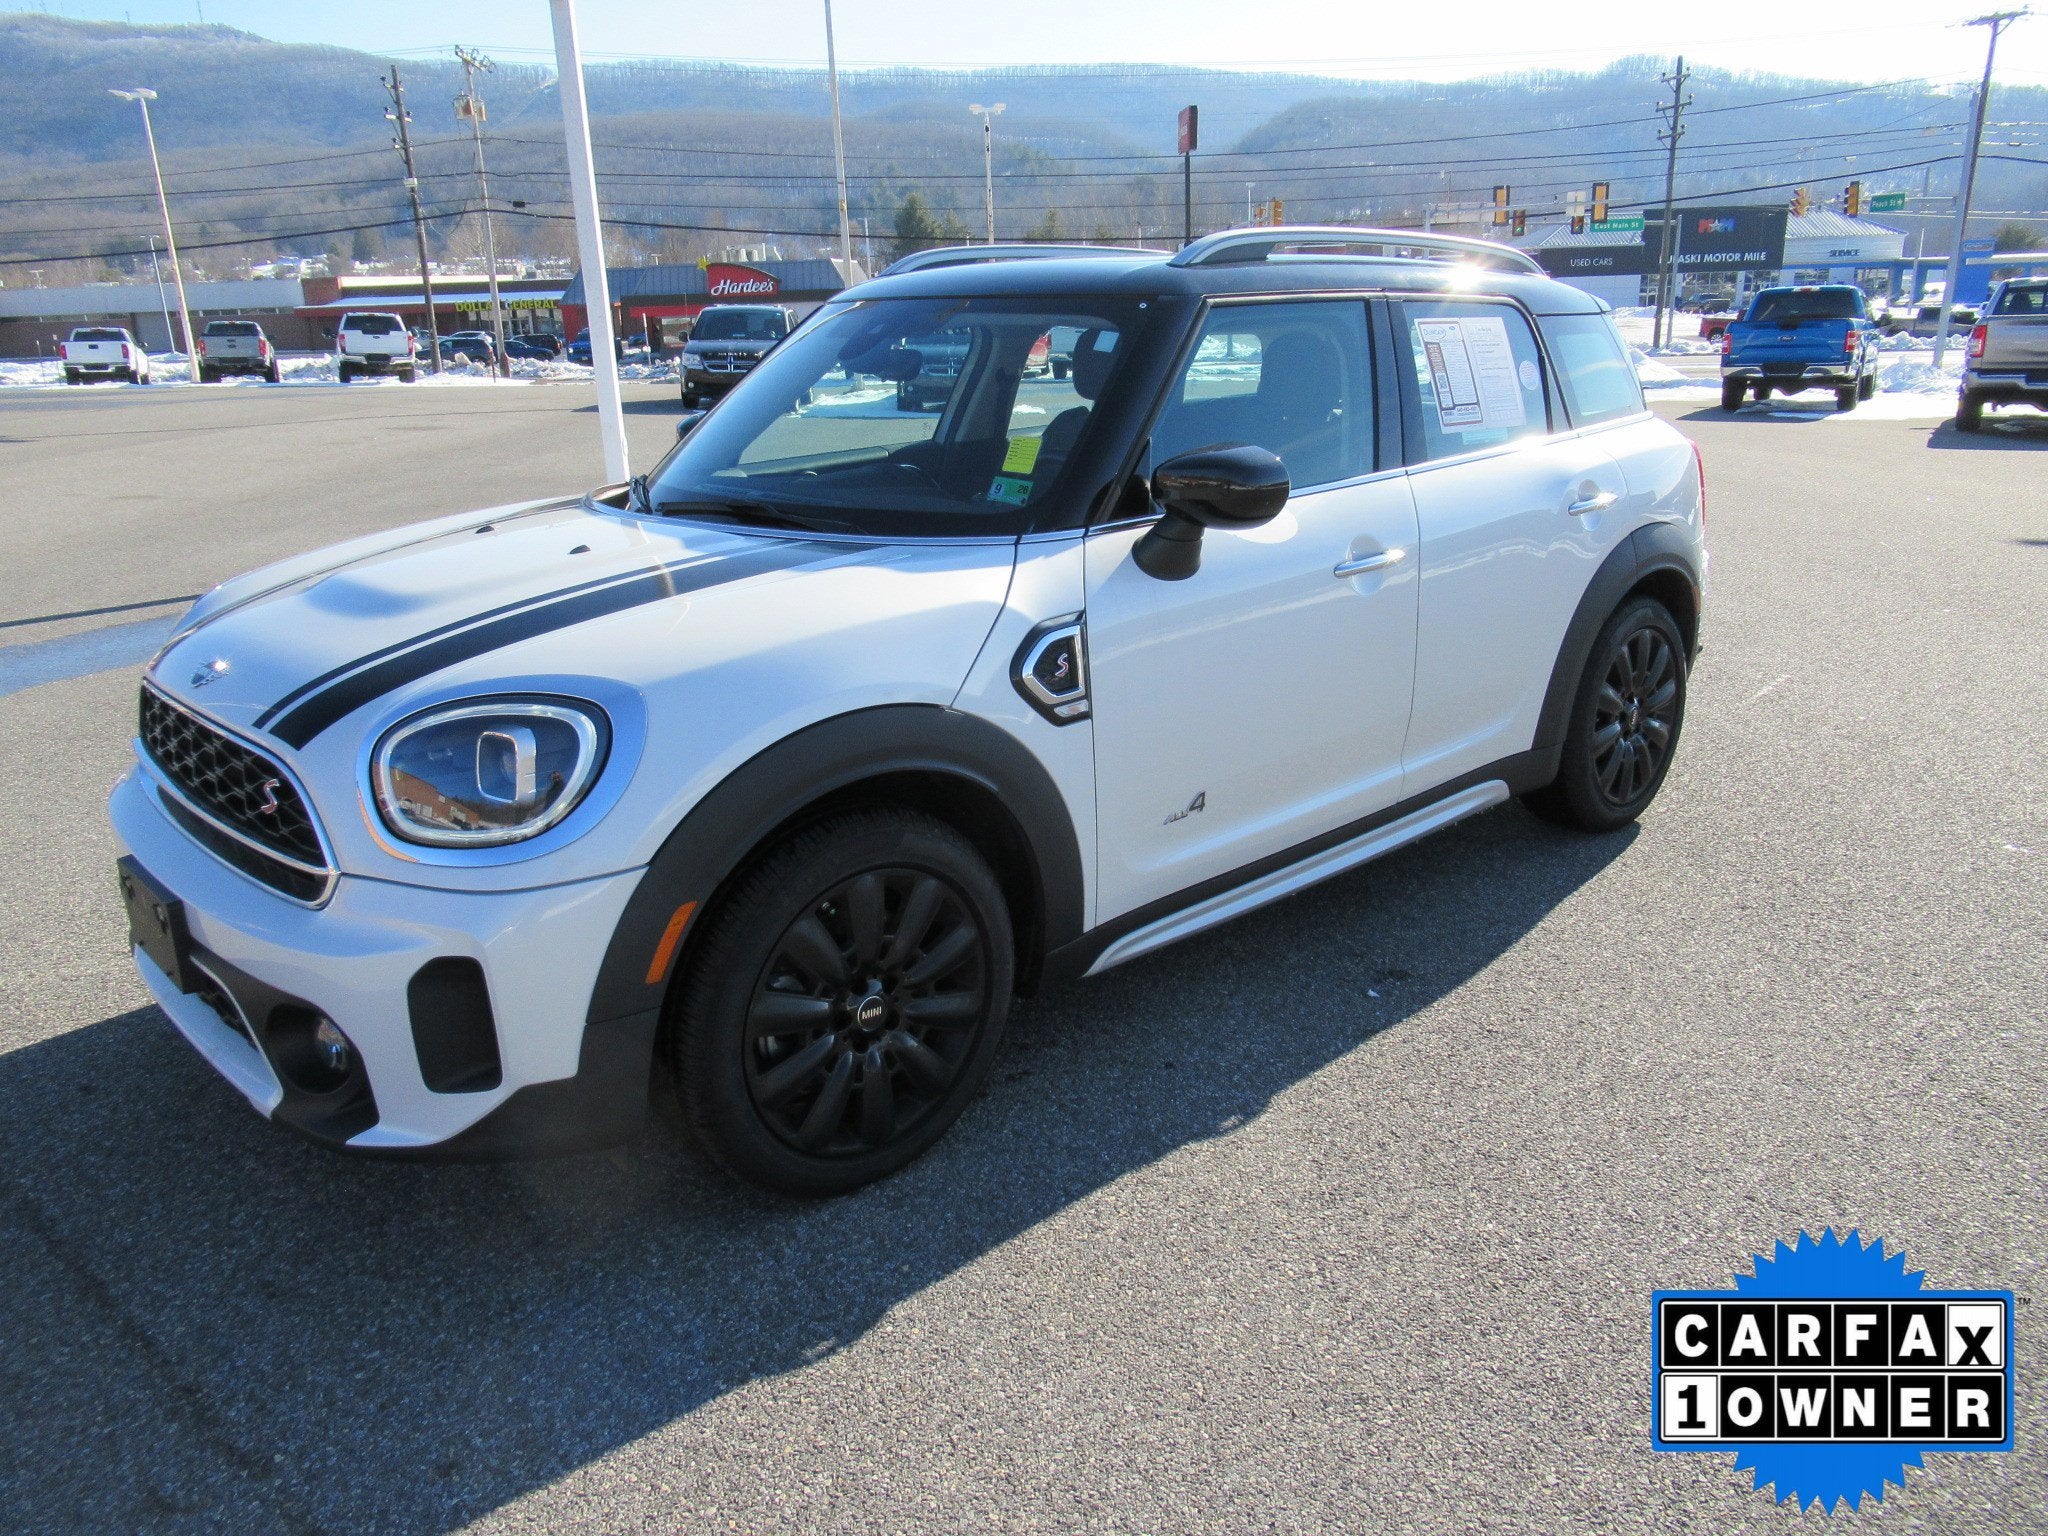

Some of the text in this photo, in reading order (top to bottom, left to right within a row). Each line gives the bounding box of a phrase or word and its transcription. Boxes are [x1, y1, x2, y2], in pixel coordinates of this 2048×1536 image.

[1703, 252, 1741, 263] MOTOR
[1744, 251, 1767, 261] MILE
[1829, 248, 1860, 257] SERVICE
[1570, 257, 1613, 267] USED CARS
[711, 278, 774, 296] Hardee's
[456, 299, 558, 312] DOLLA GENERAL
[994, 483, 1029, 494] 9 26
[1054, 652, 1069, 678] S
[261, 778, 280, 815] S
[861, 1005, 882, 1020] MINI
